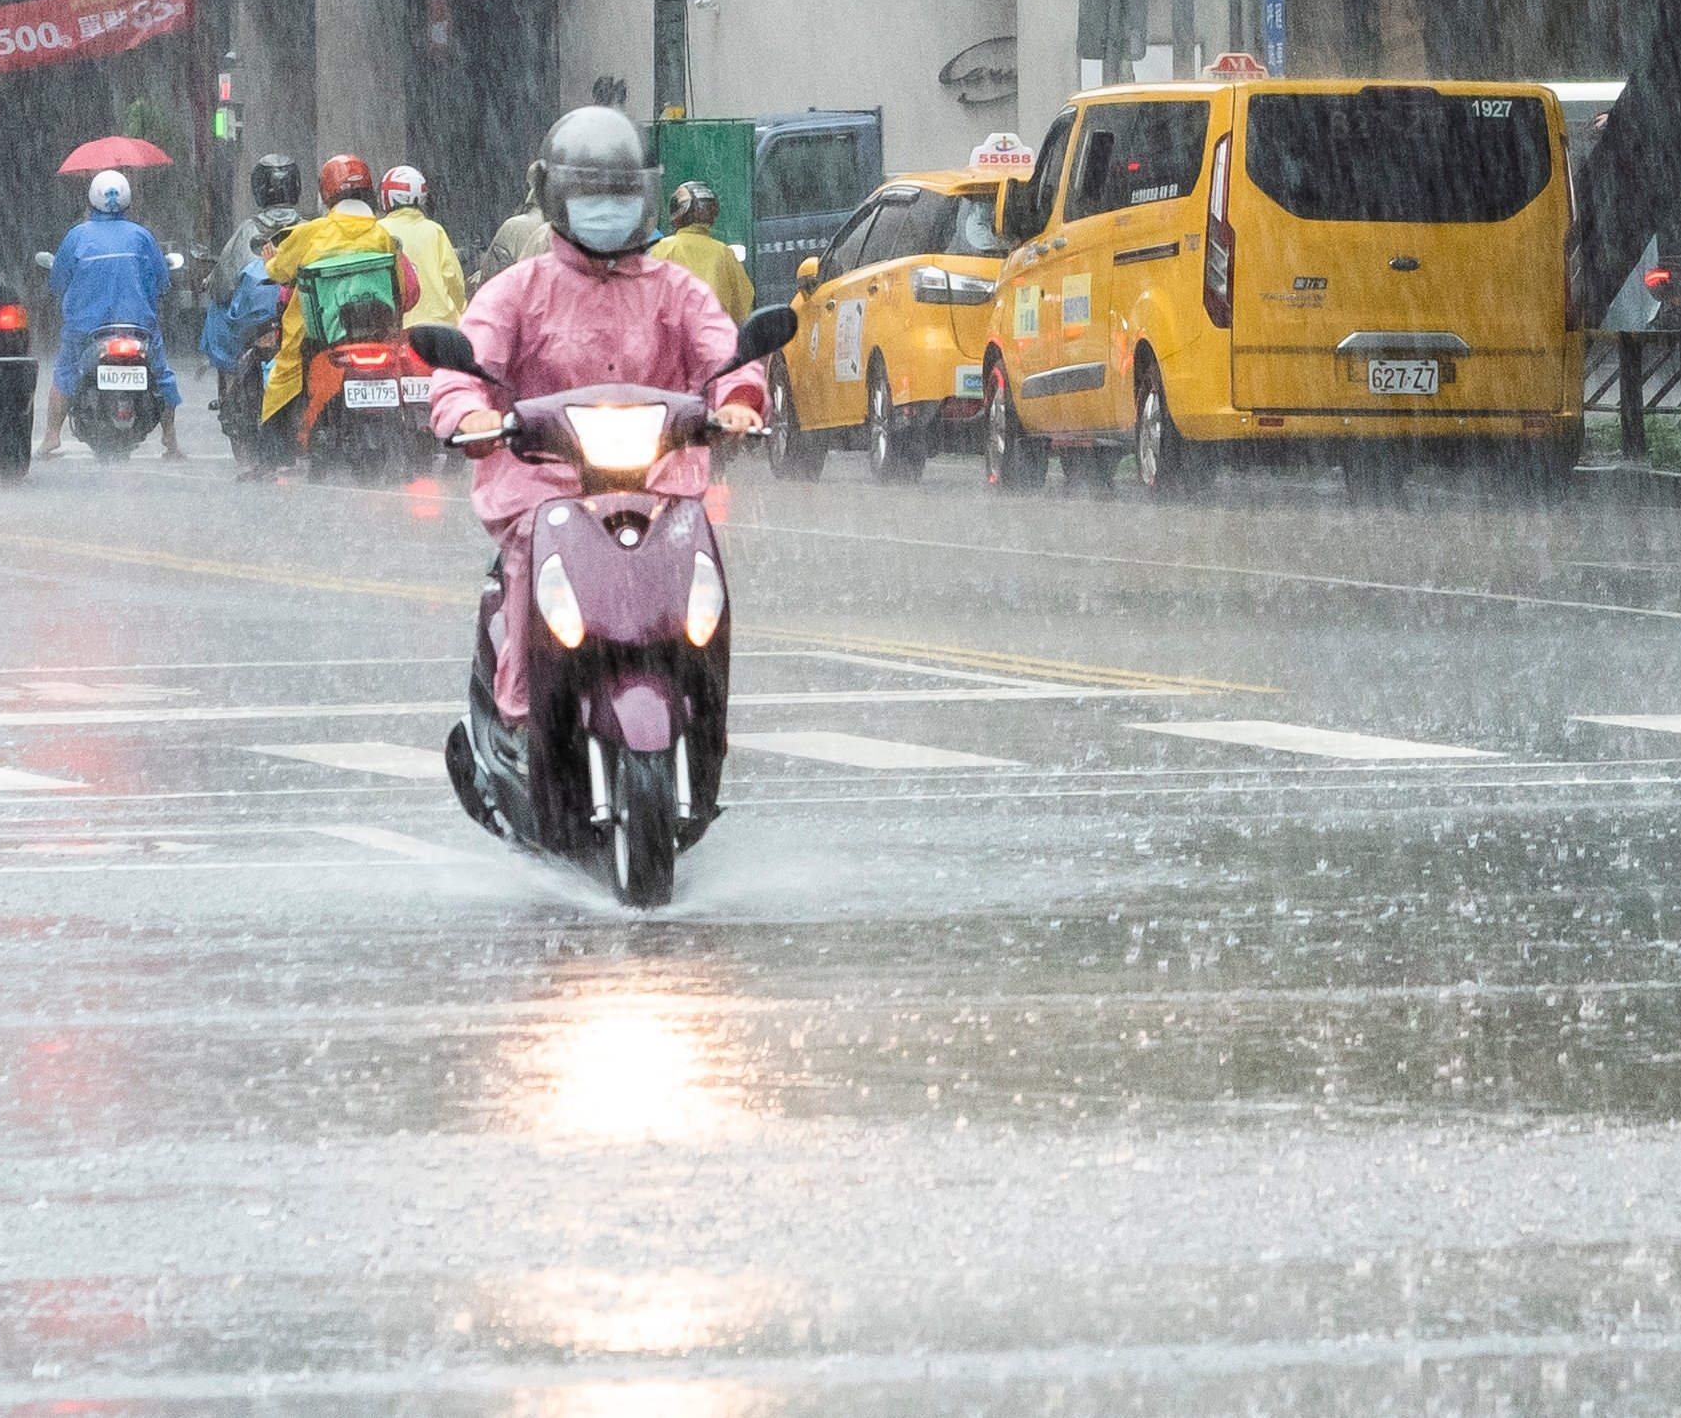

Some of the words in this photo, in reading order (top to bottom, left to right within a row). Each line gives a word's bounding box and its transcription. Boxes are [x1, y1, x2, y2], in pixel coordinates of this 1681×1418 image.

[1471, 99, 1513, 118] 1927
[978, 153, 1032, 164] 55688
[99, 371, 145, 385] NAD-9783
[1371, 367, 1437, 391] 627-Z7
[346, 386, 397, 402] EPQ-1795
